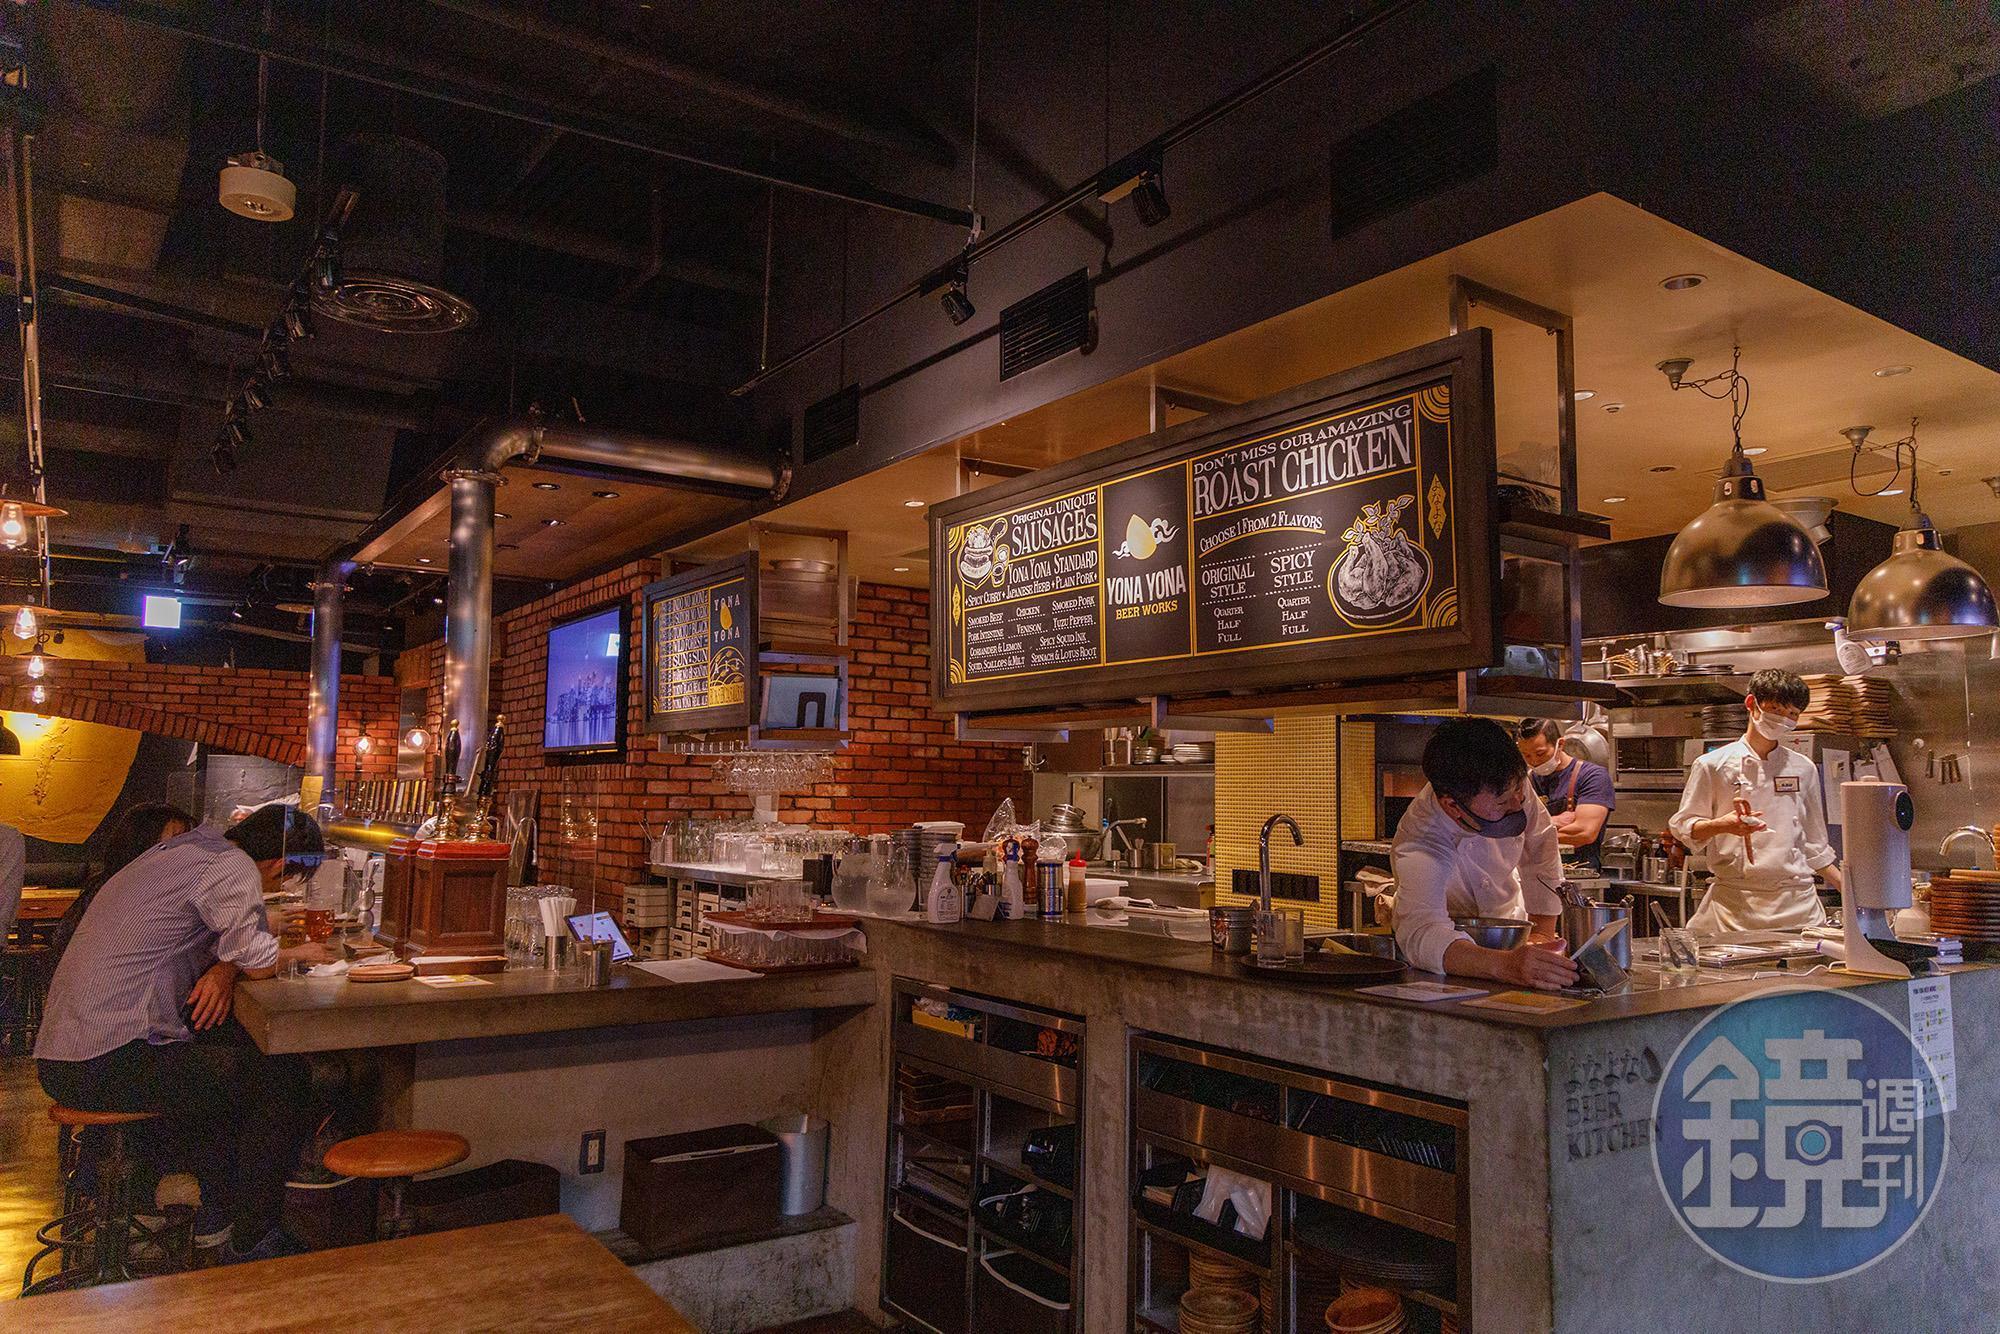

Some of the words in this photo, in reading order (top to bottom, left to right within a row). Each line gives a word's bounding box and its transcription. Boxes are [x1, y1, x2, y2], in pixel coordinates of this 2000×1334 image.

[1194, 452, 1237, 475] DON'T
[1241, 442, 1276, 462] MISS
[1280, 432, 1315, 450] OUR
[1315, 404, 1411, 442] AMAZING
[1194, 456, 1276, 515] ROAST
[1282, 419, 1413, 493] CHICKEN
[1012, 507, 1055, 525] ORIGINAL
[1056, 491, 1097, 514] UNIQUE
[1012, 508, 1097, 557] SAUSAGES
[1200, 525, 1236, 552] CHOOSE
[1242, 515, 1271, 535] FROM
[1271, 514, 1277, 527] 2
[1278, 511, 1323, 530] FLAVORS
[1008, 562, 1029, 584] YONA
[1029, 558, 1051, 580] YONA
[1054, 550, 1098, 574] STANDARD
[1270, 550, 1316, 574] SPICY
[1201, 562, 1255, 586] ORIGINAL
[1274, 570, 1314, 588] STYLE
[968, 595, 983, 607] SPICY
[984, 591, 1001, 604] CURRY
[1006, 583, 1033, 600] JAPANESE
[1034, 582, 1050, 595] HERB
[1056, 576, 1076, 590] PLAIN
[1076, 572, 1094, 586] PORK
[1106, 576, 1143, 605] YONA
[1145, 565, 1186, 601] YONA
[1210, 581, 1246, 599] STYLE
[713, 593, 741, 612] YONA
[1052, 599, 1078, 612] SMOKED
[1078, 595, 1095, 607] PORK
[1115, 606, 1140, 620] BEER
[1142, 600, 1178, 616] WORKS
[1277, 596, 1311, 610] QUARTER
[1015, 605, 1040, 618] CHICKEN
[1069, 614, 1093, 626] PEPPER
[1213, 606, 1244, 618] QUARTER
[1281, 610, 1309, 621] HALF
[1016, 623, 1042, 635] VENISON
[1217, 619, 1241, 630] HALF
[1282, 624, 1309, 635] FULL
[713, 626, 740, 643] YONA
[1039, 636, 1056, 648] SPICY
[1056, 633, 1074, 646] SQUID
[1075, 631, 1087, 642] INK
[1218, 633, 1242, 643] FULL
[1002, 641, 1022, 653] LEMON
[1060, 648, 1080, 660] LOTUS
[1080, 646, 1097, 658] ROOT
